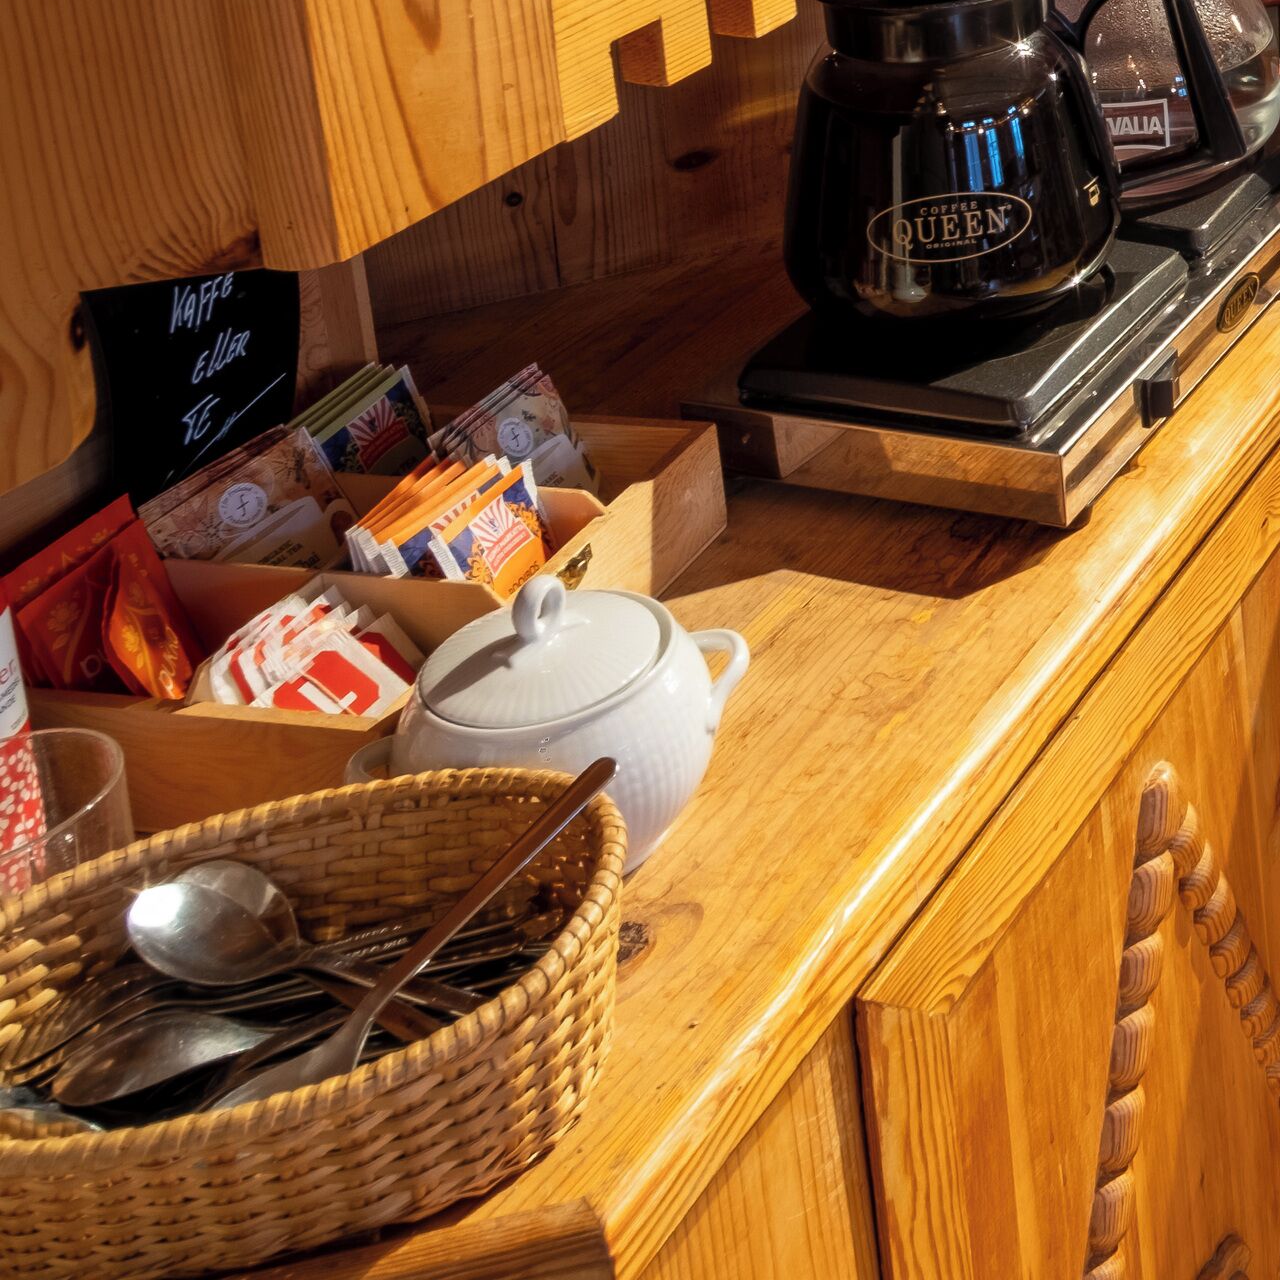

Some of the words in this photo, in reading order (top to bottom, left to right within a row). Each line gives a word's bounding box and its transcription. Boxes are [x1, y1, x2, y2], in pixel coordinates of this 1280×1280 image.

[1105, 115, 1164, 136] VALIA
[919, 200, 979, 216] COFFEE
[893, 206, 1006, 251] QUEEN
[925, 237, 978, 250] ORIGINAL
[169, 271, 235, 335] KAFFE
[180, 393, 222, 446] TE
